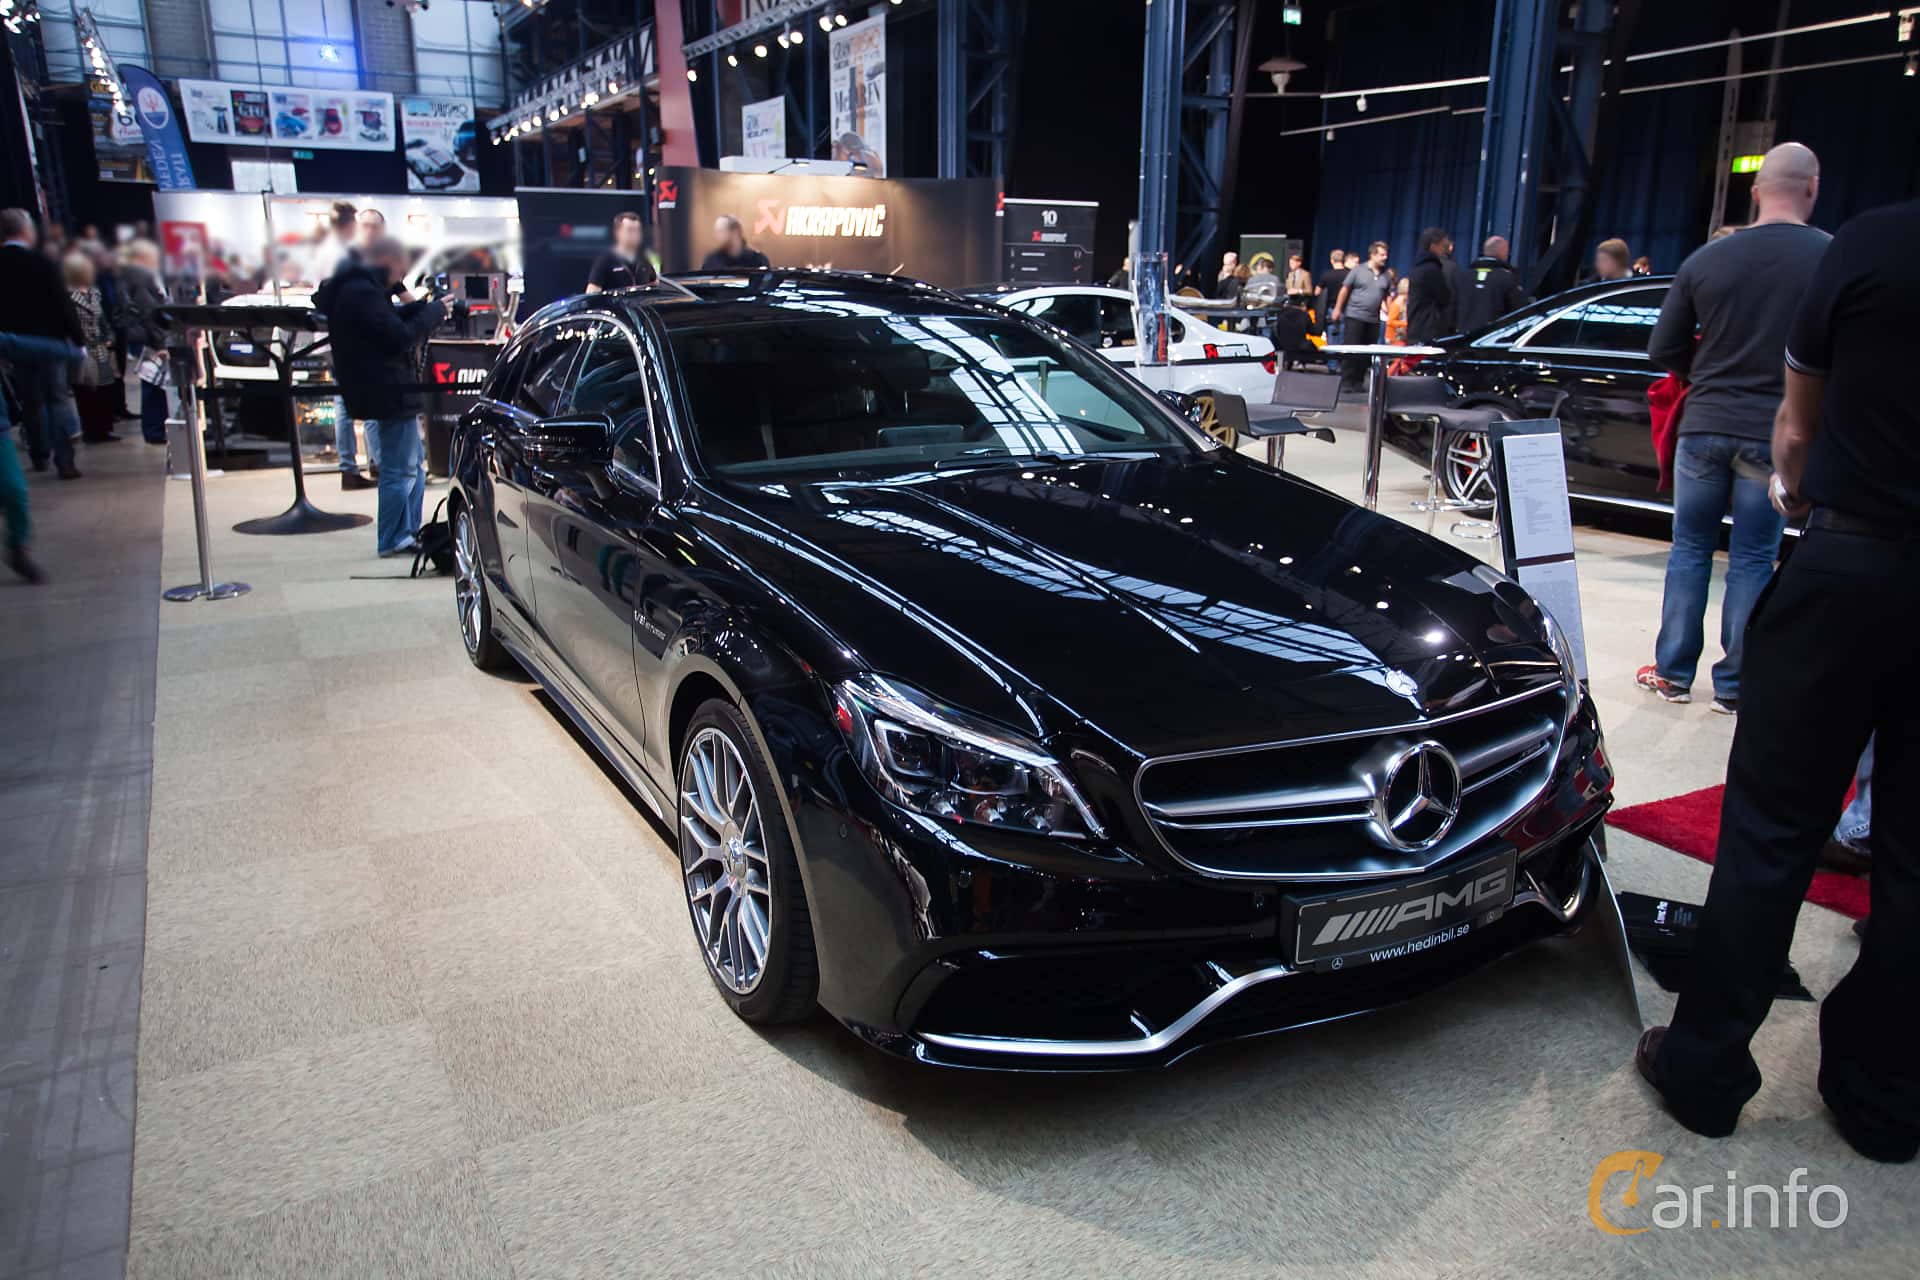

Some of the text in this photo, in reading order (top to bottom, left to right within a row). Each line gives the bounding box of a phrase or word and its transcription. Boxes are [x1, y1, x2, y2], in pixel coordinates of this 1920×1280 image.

[1041, 210, 1058, 225] 10
[1387, 867, 1508, 931] AMG
[1369, 923, 1470, 963] www.hedinbil.se
